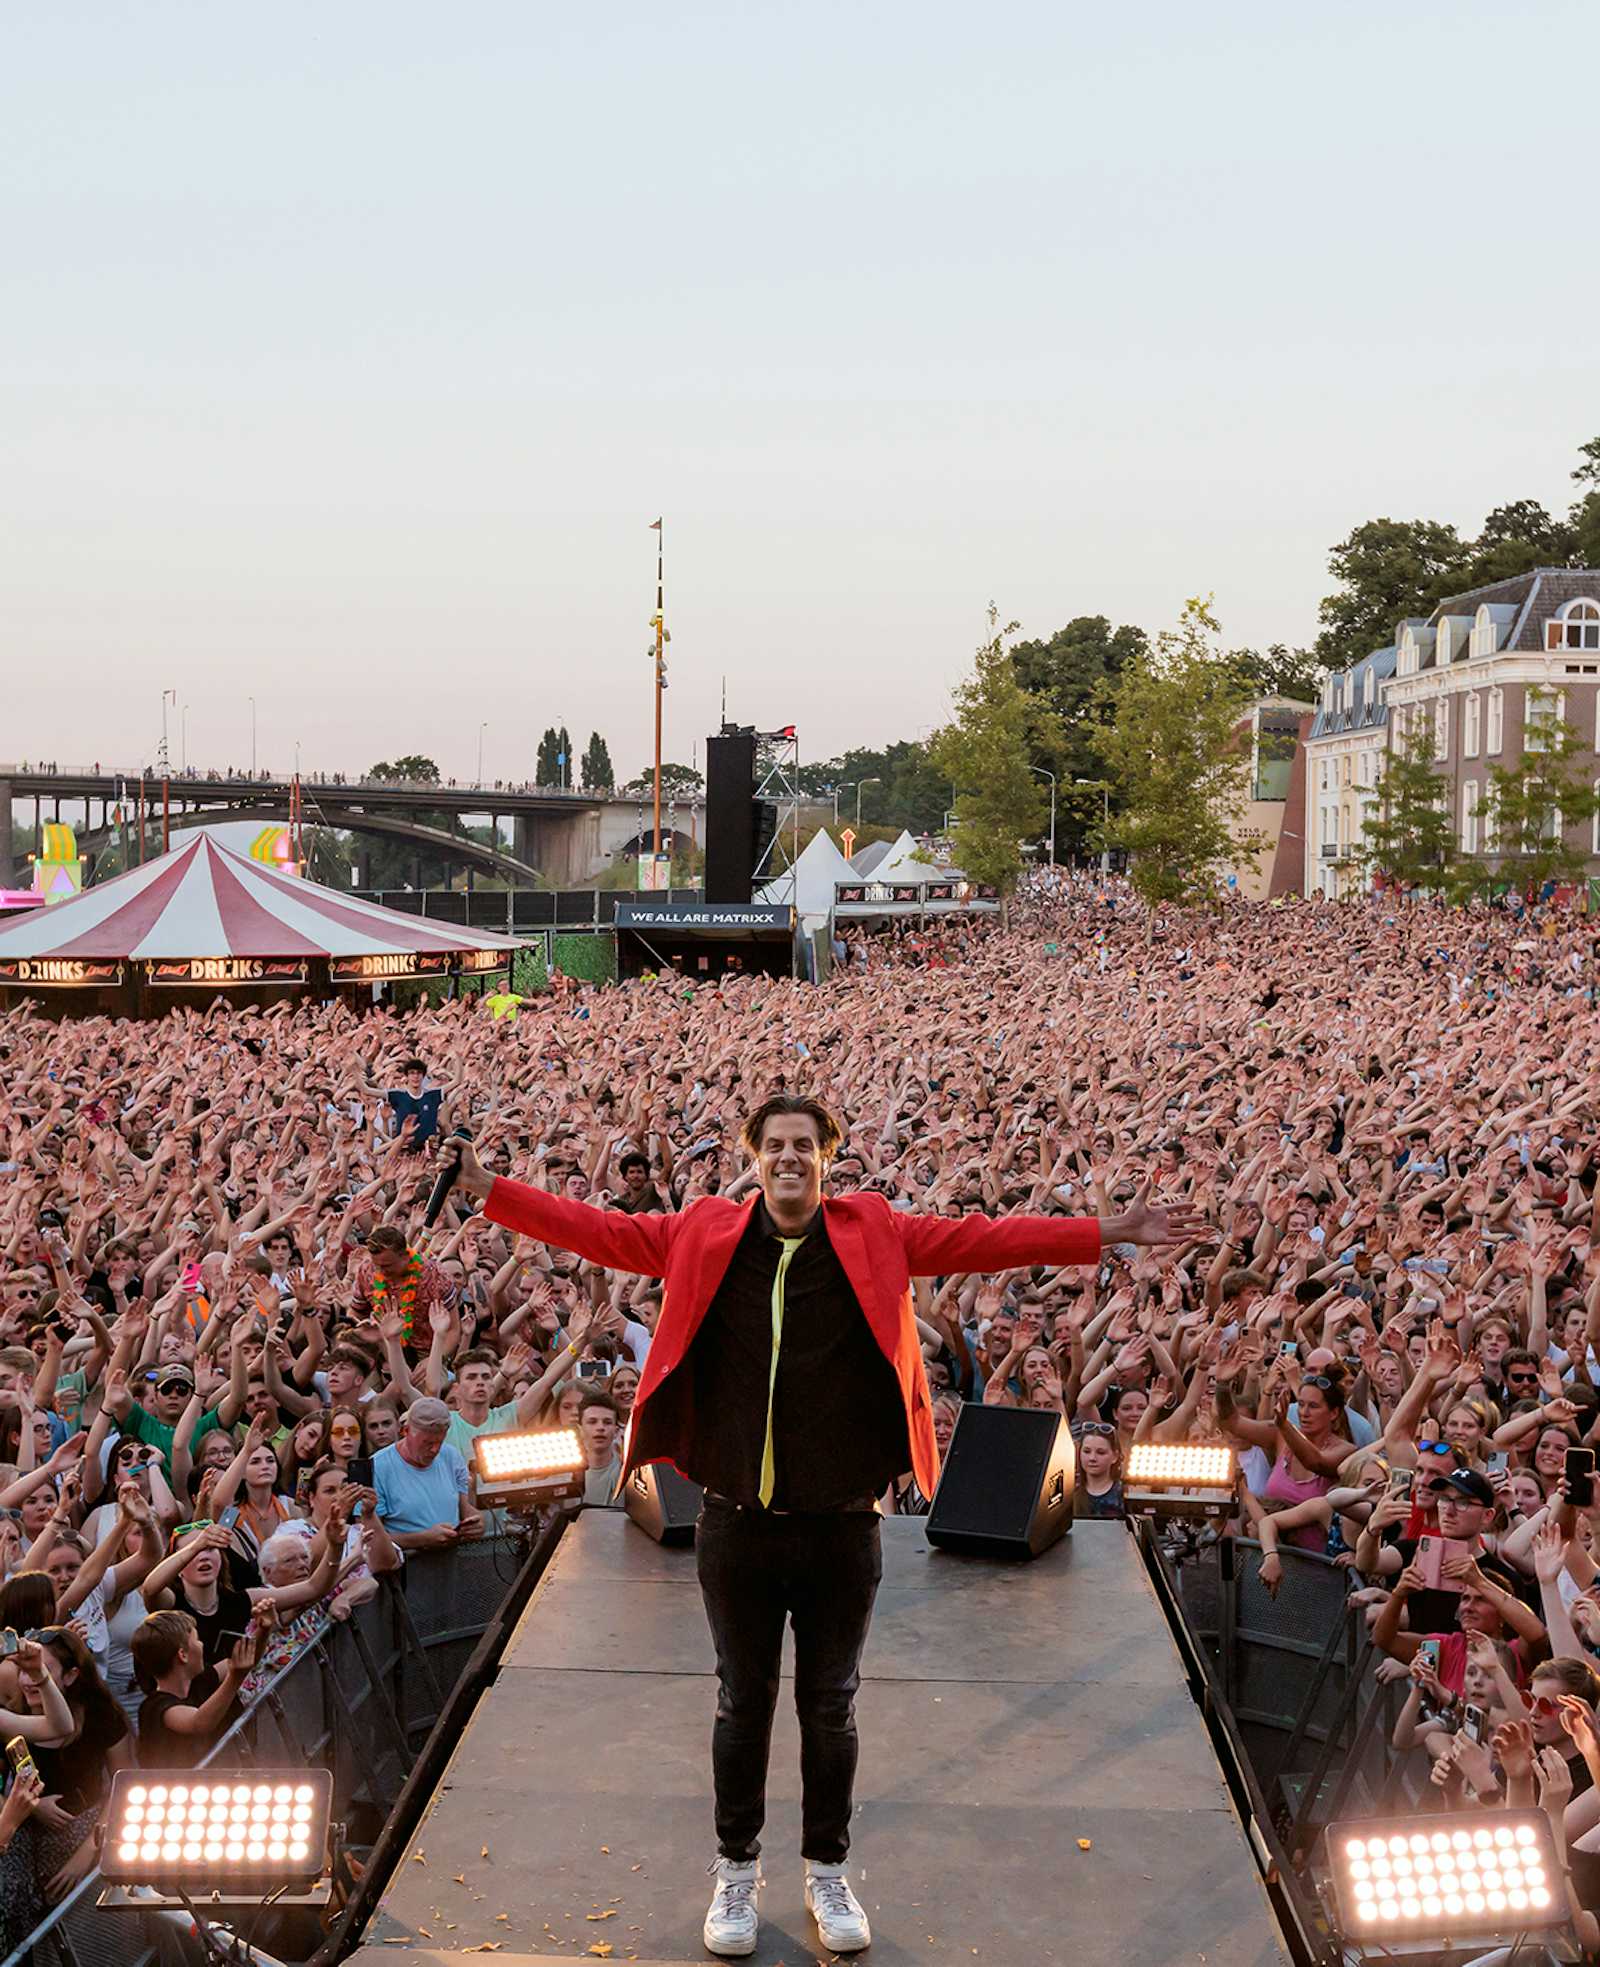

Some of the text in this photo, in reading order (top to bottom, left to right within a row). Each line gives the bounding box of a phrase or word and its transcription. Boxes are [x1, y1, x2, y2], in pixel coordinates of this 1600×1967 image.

[631, 912, 774, 923] WE ALL ARE MATRIXX
[362, 955, 417, 975] DRINKS
